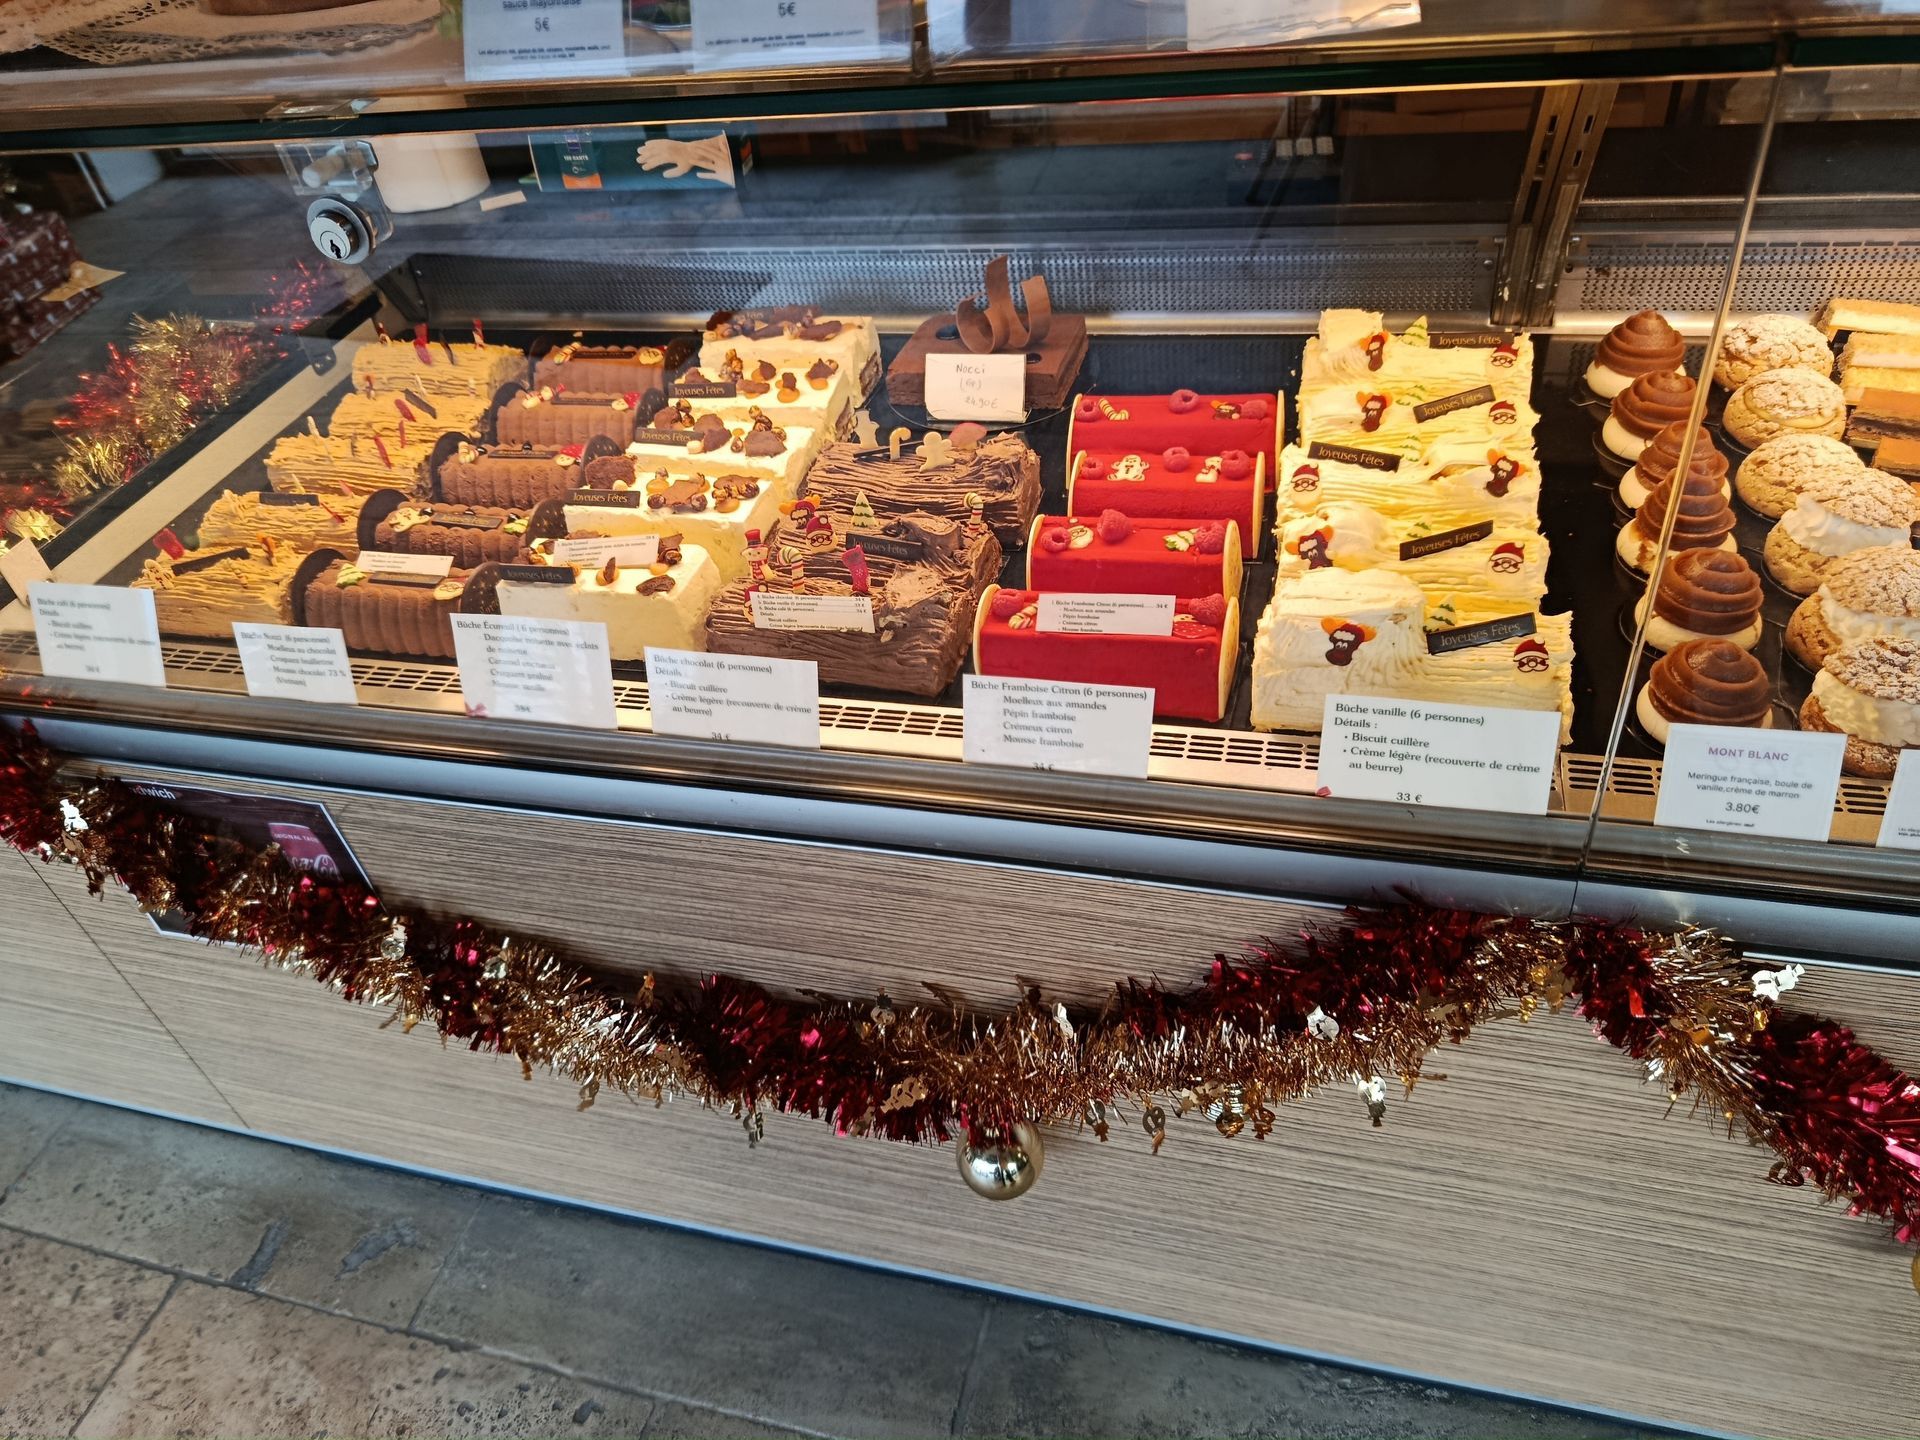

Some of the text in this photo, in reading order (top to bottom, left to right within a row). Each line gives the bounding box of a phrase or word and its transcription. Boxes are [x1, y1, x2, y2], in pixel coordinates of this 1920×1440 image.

[778, 2, 797, 17] 5€
[535, 17, 550, 32] 5€
[1438, 335, 1502, 346] Joyeuses Fêtes
[674, 386, 725, 397] Joyeuses Fêtes
[1423, 392, 1485, 417] Joyeuses Fêtes
[641, 431, 692, 442] Joyeuses Fêtes
[1318, 446, 1385, 467] Joyeuses Fêtes
[573, 492, 628, 503] Joyeuses Fêtes
[1410, 530, 1481, 555] Joyeuses Fêtes
[457, 621, 481, 629] Bûche
[1440, 622, 1521, 648] Joyeuses Fêtes
[654, 655, 772, 674] Bûche chocolat (6 personnes)
[655, 667, 682, 677] Détails
[670, 681, 696, 691] Biscuit
[971, 680, 1147, 700] Bûche Framboise Citron (6 personnes)
[672, 693, 812, 714] Crème légère (recouverte de crème
[1003, 695, 1107, 711] Moelleux aux amandes
[684, 706, 712, 716] beurre)
[1003, 708, 1077, 721] Pépin framboise
[1335, 703, 1485, 726] Bûche vanille (6 personnes)
[1003, 722, 1073, 734] Crémeux citron
[1334, 717, 1371, 728] Détails
[1003, 735, 1084, 749] Mousse framboise
[1351, 732, 1430, 748] Biscuit cuillère
[1350, 747, 1540, 773] Crème légère (recouverte de crème
[1708, 746, 1790, 762] MONT BLANC
[1349, 761, 1403, 774] au beurre)
[1688, 772, 1813, 790] Meringue française, boule de
[1396, 792, 1423, 803] 33 €
[1755, 788, 1766, 796] de
[1769, 790, 1800, 799] marron
[1725, 801, 1760, 814] 3.80€
